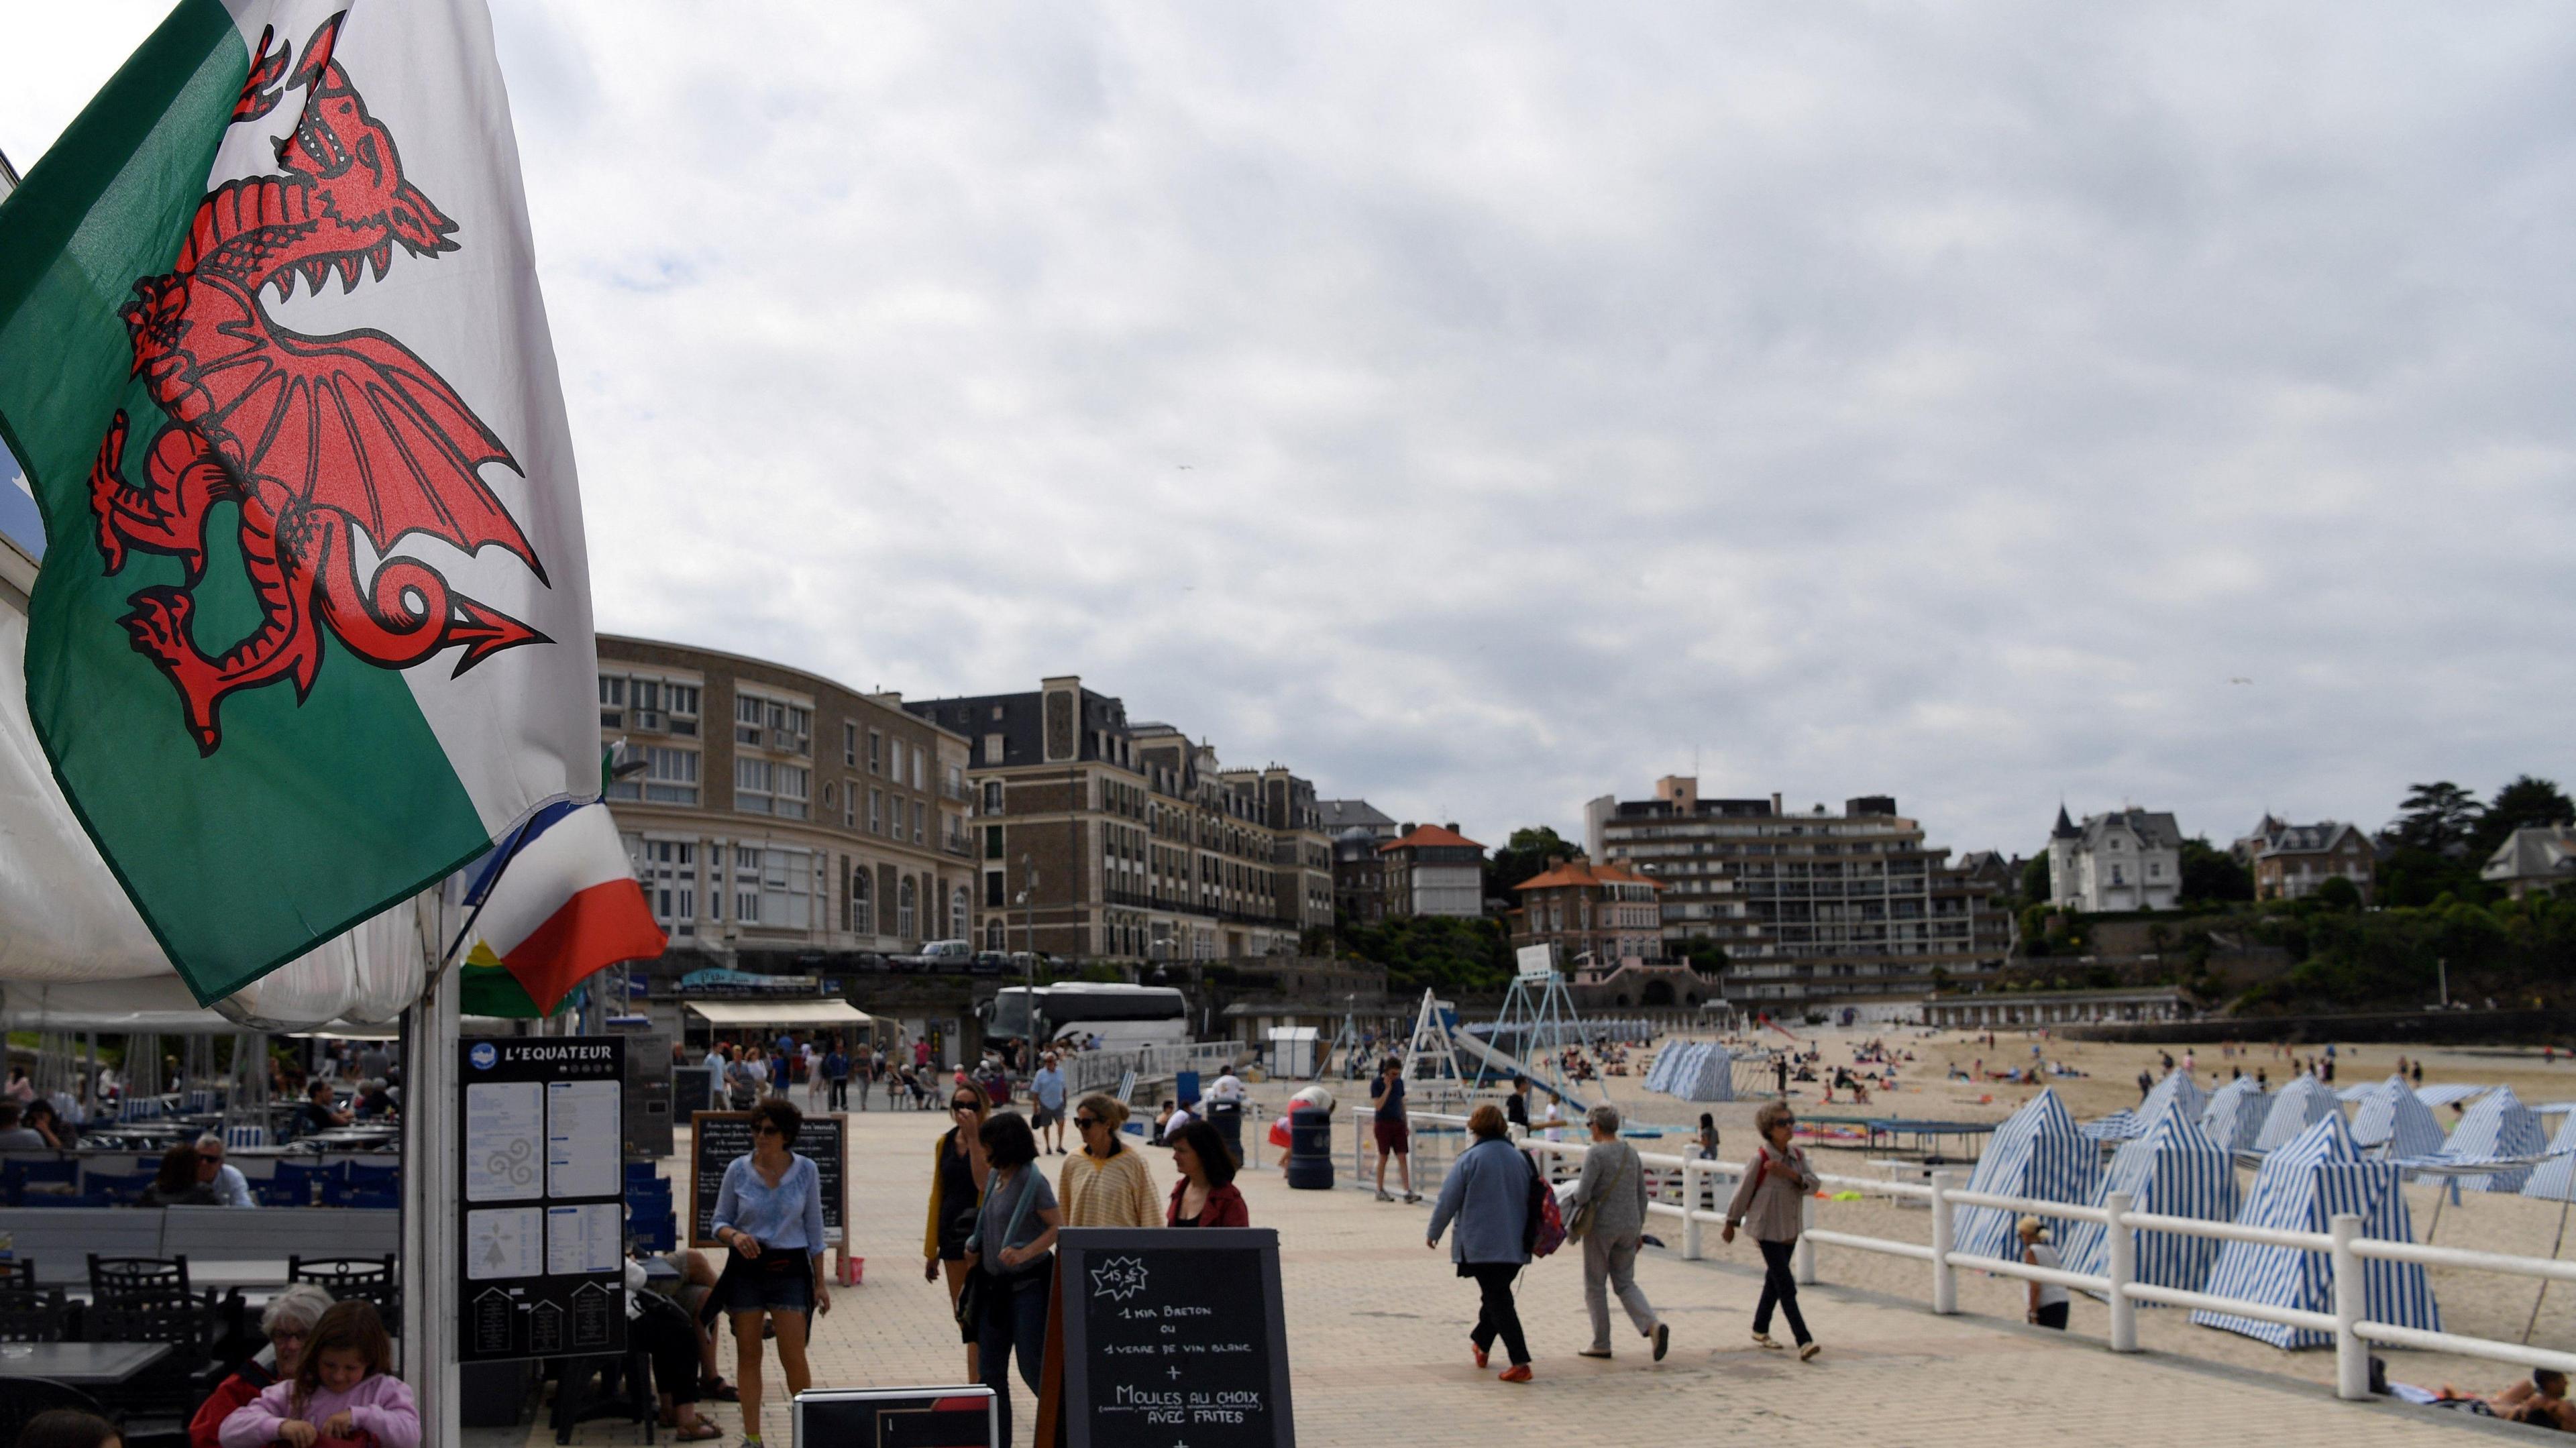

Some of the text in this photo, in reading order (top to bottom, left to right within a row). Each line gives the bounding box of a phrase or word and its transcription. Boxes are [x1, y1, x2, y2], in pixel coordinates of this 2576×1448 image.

[505, 1046, 612, 1061] L'EQUATEUR
[1118, 1308, 1132, 1319] 1
[1163, 1305, 1212, 1317] BRETON
[1116, 1345, 1155, 1353] VERRE
[1163, 1344, 1175, 1353] DE
[1212, 1343, 1252, 1352] BLANC
[1189, 1392, 1210, 1404] AU
[1216, 1391, 1258, 1404] CHOIX
[1147, 1410, 1244, 1424] AVEC FRITES
